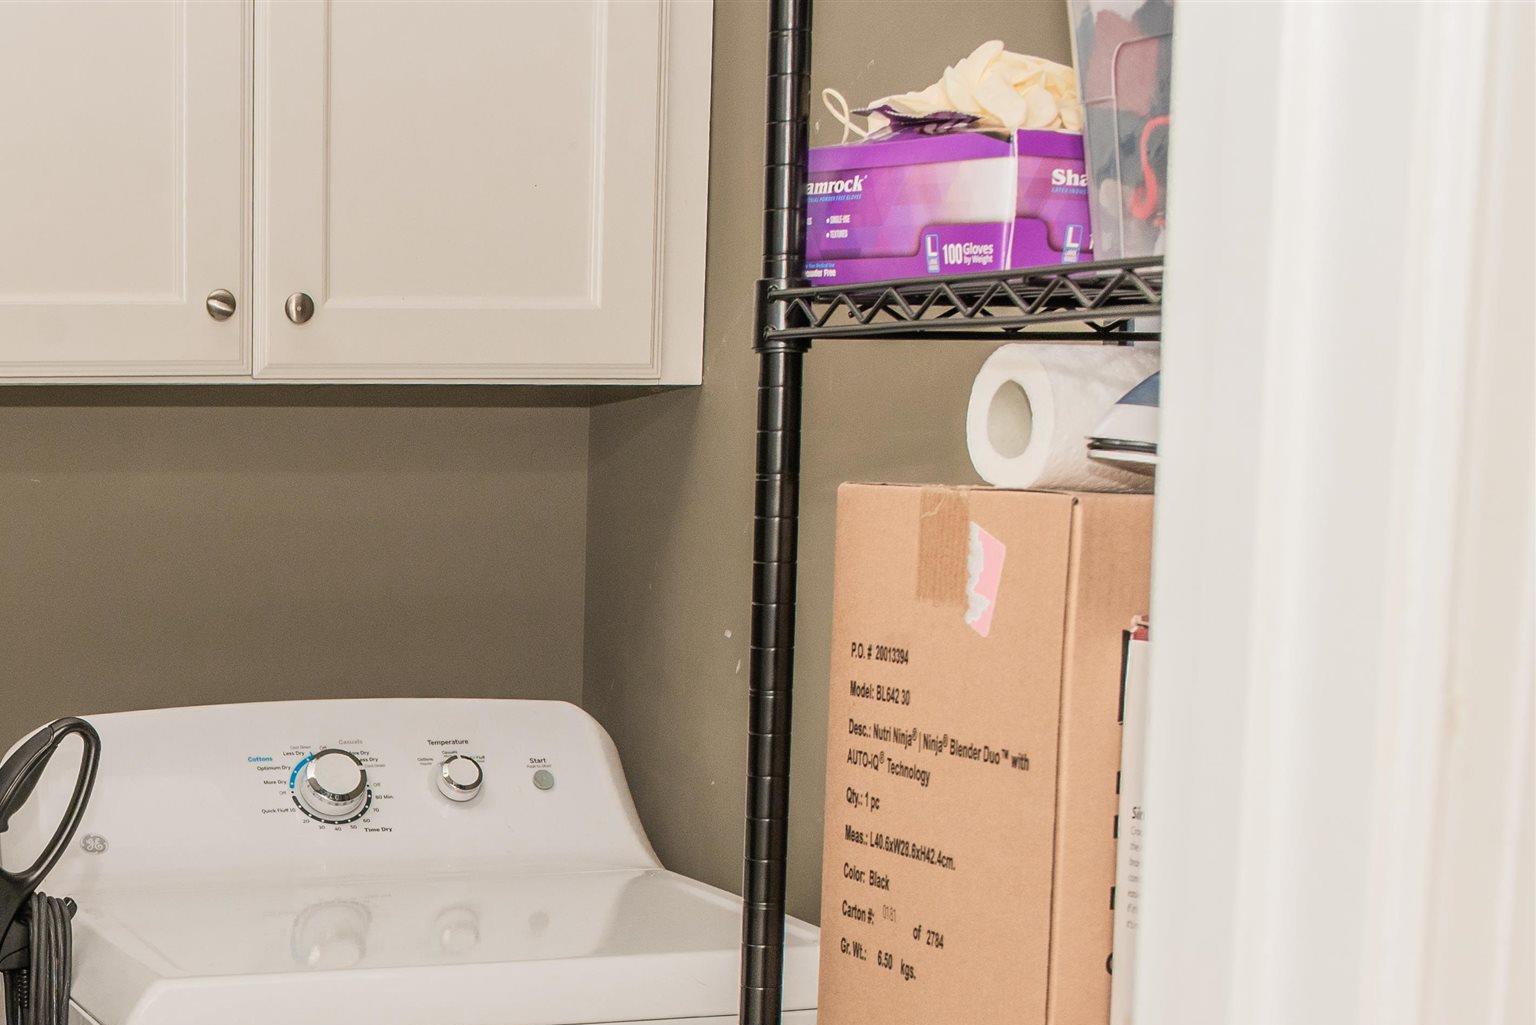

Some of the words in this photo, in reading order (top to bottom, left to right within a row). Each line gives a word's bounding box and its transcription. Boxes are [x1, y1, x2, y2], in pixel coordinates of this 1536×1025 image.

[942, 243, 962, 265] 100
[964, 242, 994, 255] Gloves
[964, 256, 972, 266] by
[972, 255, 993, 266] Weight
[851, 642, 865, 659] P.O.
[867, 644, 872, 660] #
[876, 645, 909, 665] 20013394
[850, 680, 874, 699] Model:
[876, 685, 900, 704] BL642
[902, 689, 910, 706] 30
[848, 718, 871, 738] Desc.:
[873, 723, 891, 742] Nutri
[950, 738, 982, 761] Blender
[1011, 752, 1030, 771] with
[887, 757, 931, 787] Technology
[846, 786, 863, 809] Qty.:
[865, 792, 868, 807] 1
[870, 796, 880, 813] pc
[845, 824, 868, 846] Meas.:
[844, 862, 865, 883] Color:
[869, 870, 890, 891] Black
[842, 900, 866, 923] Carton
[913, 924, 922, 941] of
[926, 929, 944, 950] 2784
[840, 937, 851, 955] Gr.
[878, 950, 893, 970] 6.50
[900, 958, 916, 981] kgs.
